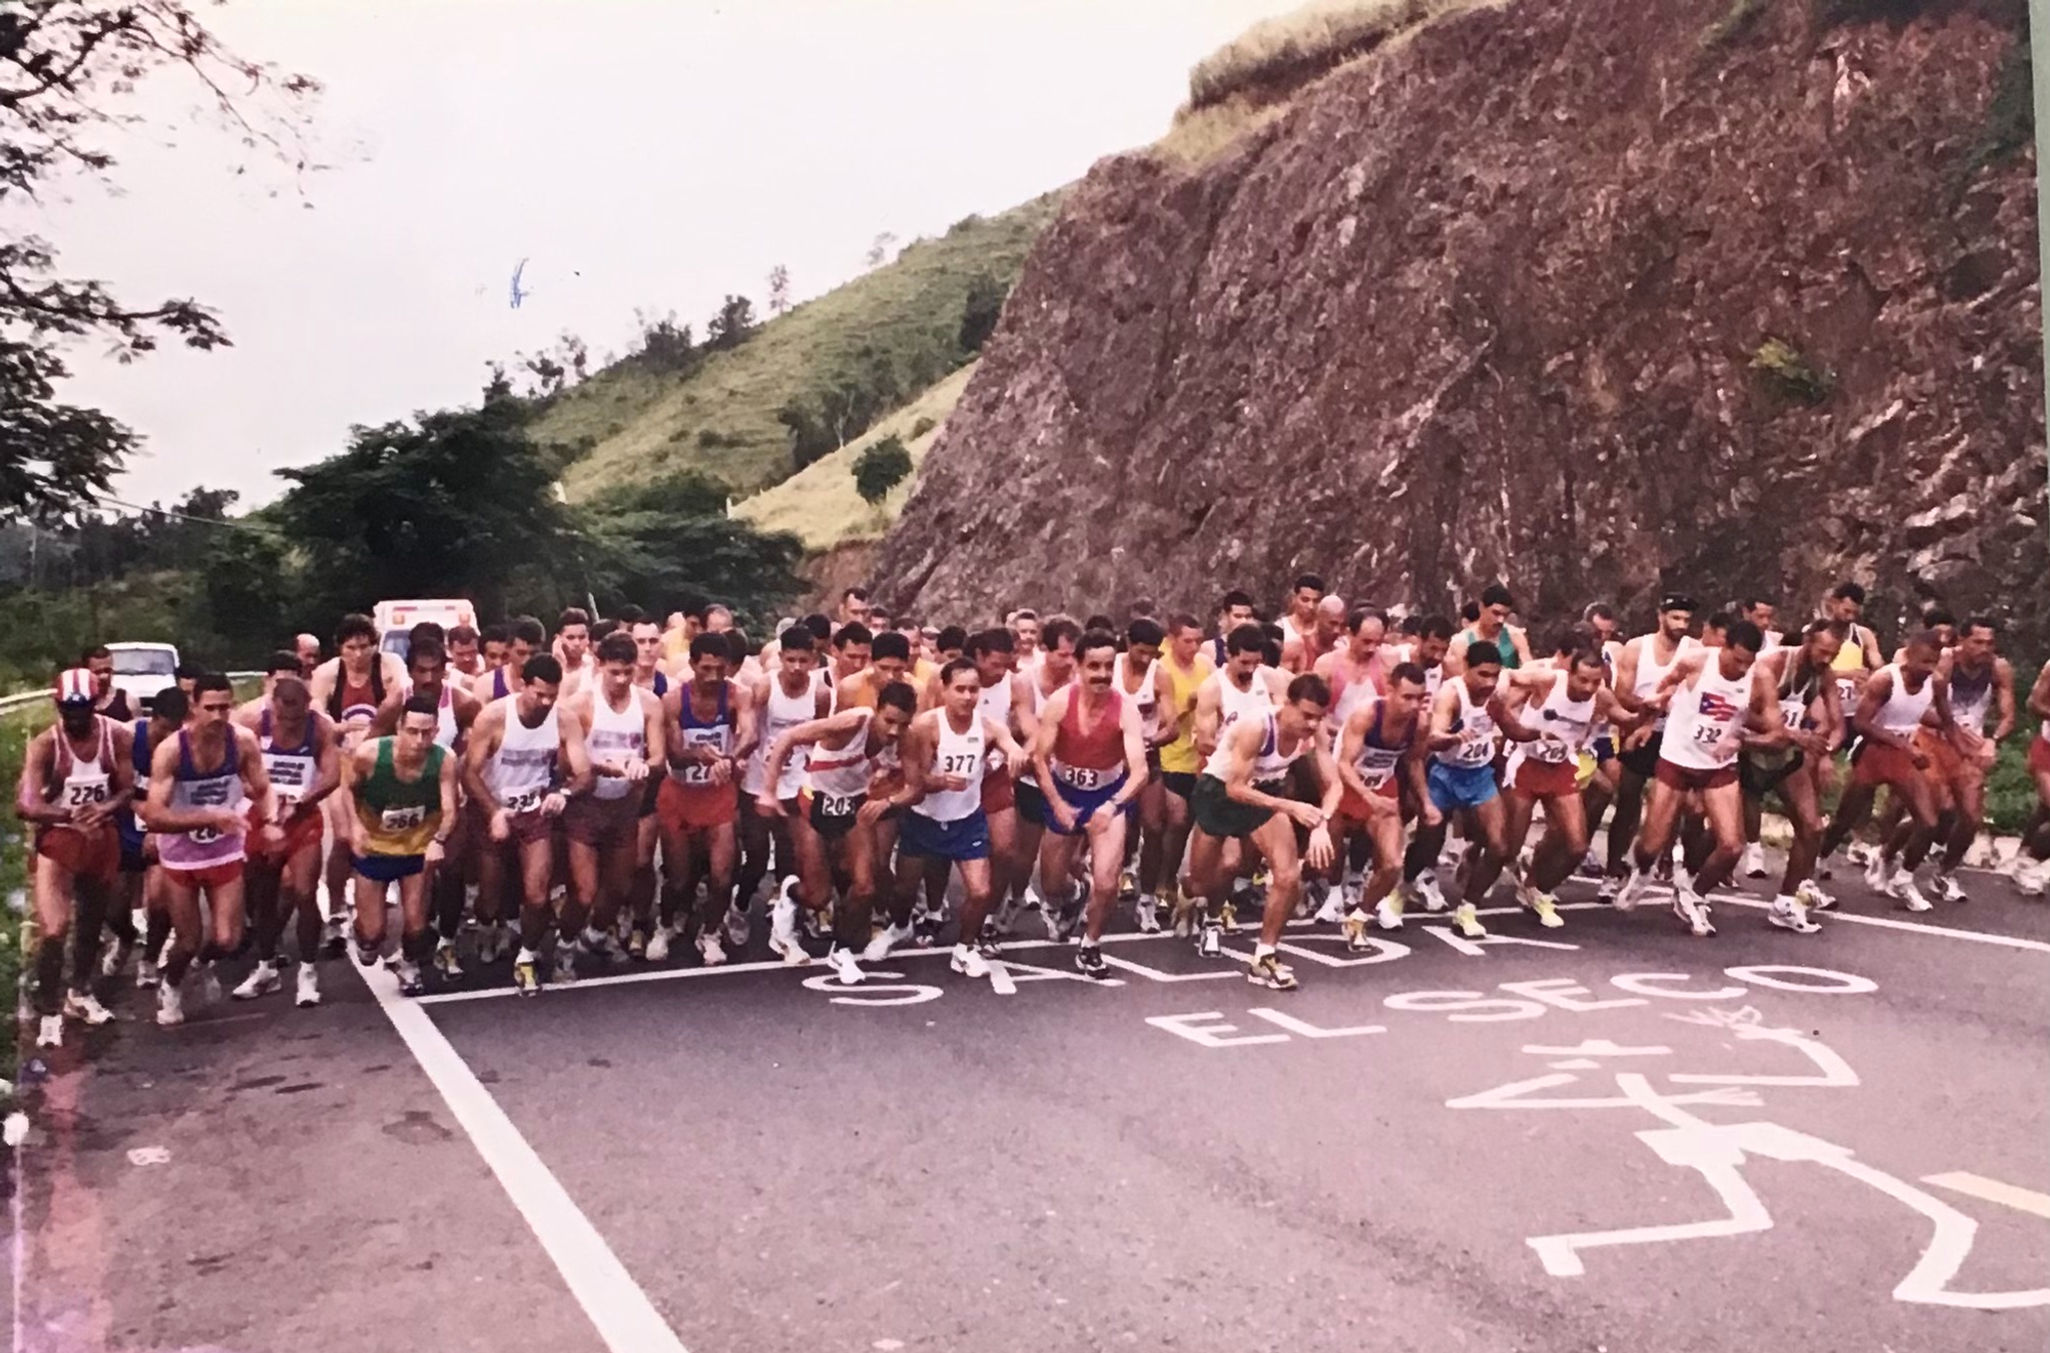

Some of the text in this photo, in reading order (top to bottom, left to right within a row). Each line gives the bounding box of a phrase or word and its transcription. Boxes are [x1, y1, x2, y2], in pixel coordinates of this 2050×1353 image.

[944, 753, 976, 774] 377
[1065, 767, 1099, 787] 363
[802, 923, 1581, 1006] SALIDA
[1145, 964, 1879, 1047] EL SECO
